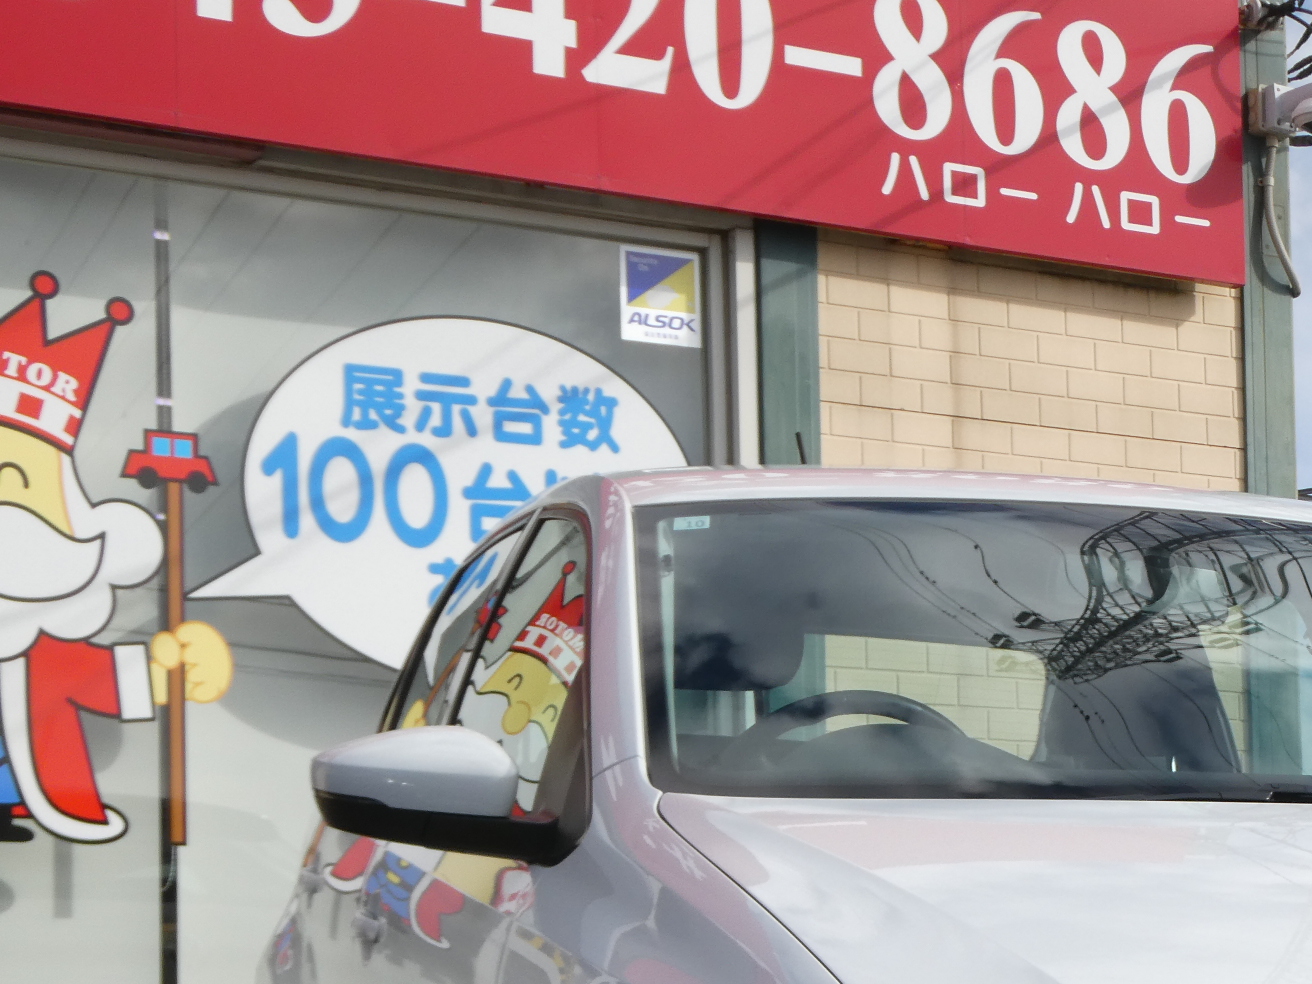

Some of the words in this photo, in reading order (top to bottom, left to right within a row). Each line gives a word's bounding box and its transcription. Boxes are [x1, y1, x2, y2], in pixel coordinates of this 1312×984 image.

[881, 152, 1038, 207] ハロー
[1066, 182, 1211, 234] ハロー
[628, 311, 696, 333] ALSOK
[340, 363, 620, 453] 展示台数
[261, 431, 600, 548] 100台
